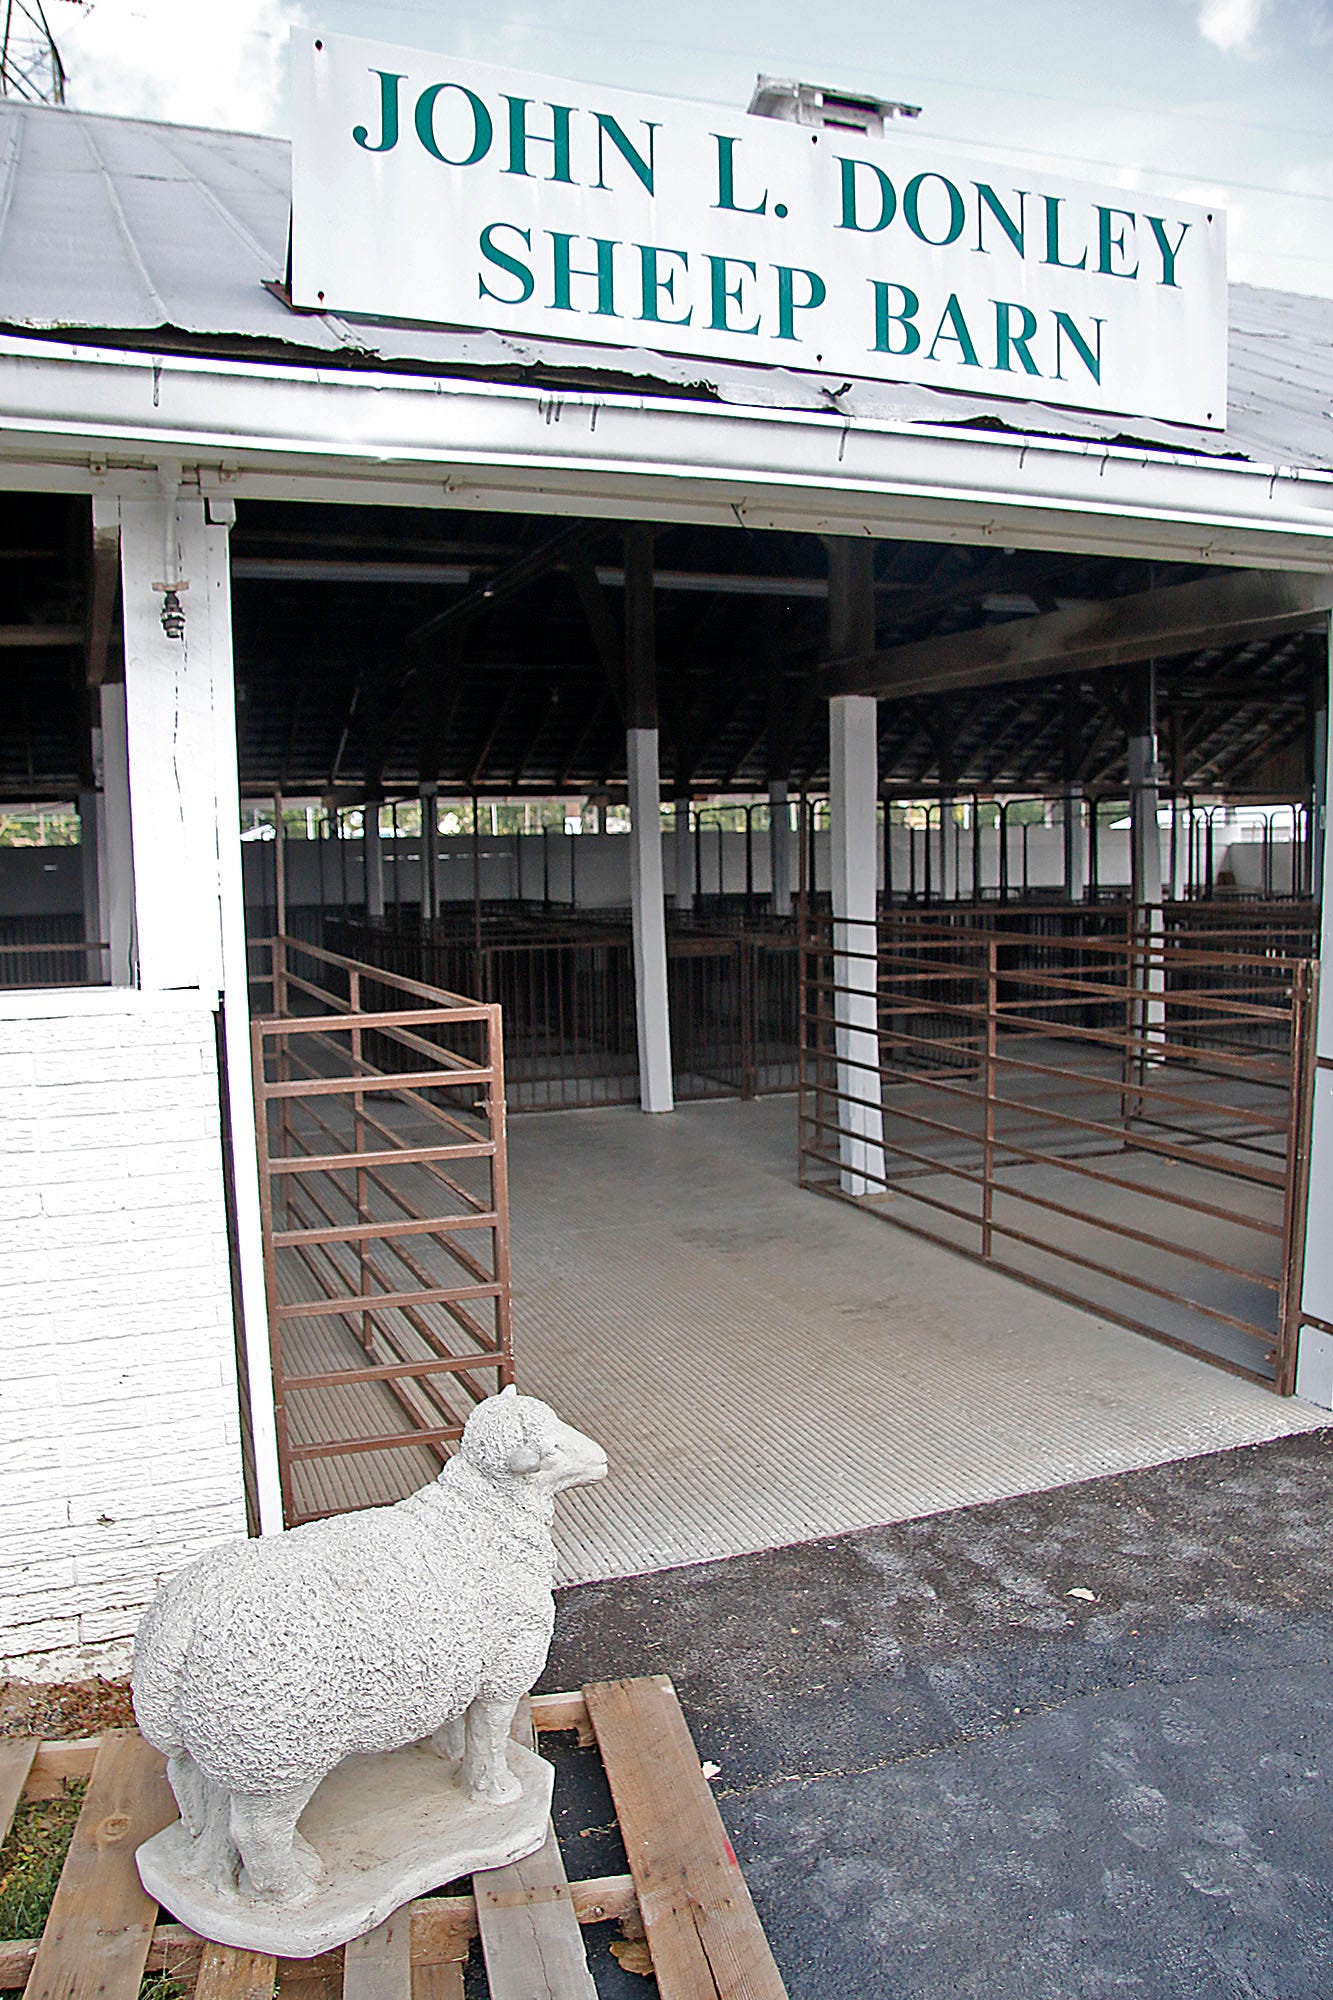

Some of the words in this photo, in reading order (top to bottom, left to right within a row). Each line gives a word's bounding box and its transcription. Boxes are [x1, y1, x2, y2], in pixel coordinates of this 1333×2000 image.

[352, 68, 663, 198] JOHN
[710, 132, 789, 218] L.
[833, 156, 1190, 289] DONLEY
[478, 222, 827, 342] SHEEP
[868, 279, 1106, 386] BARN
